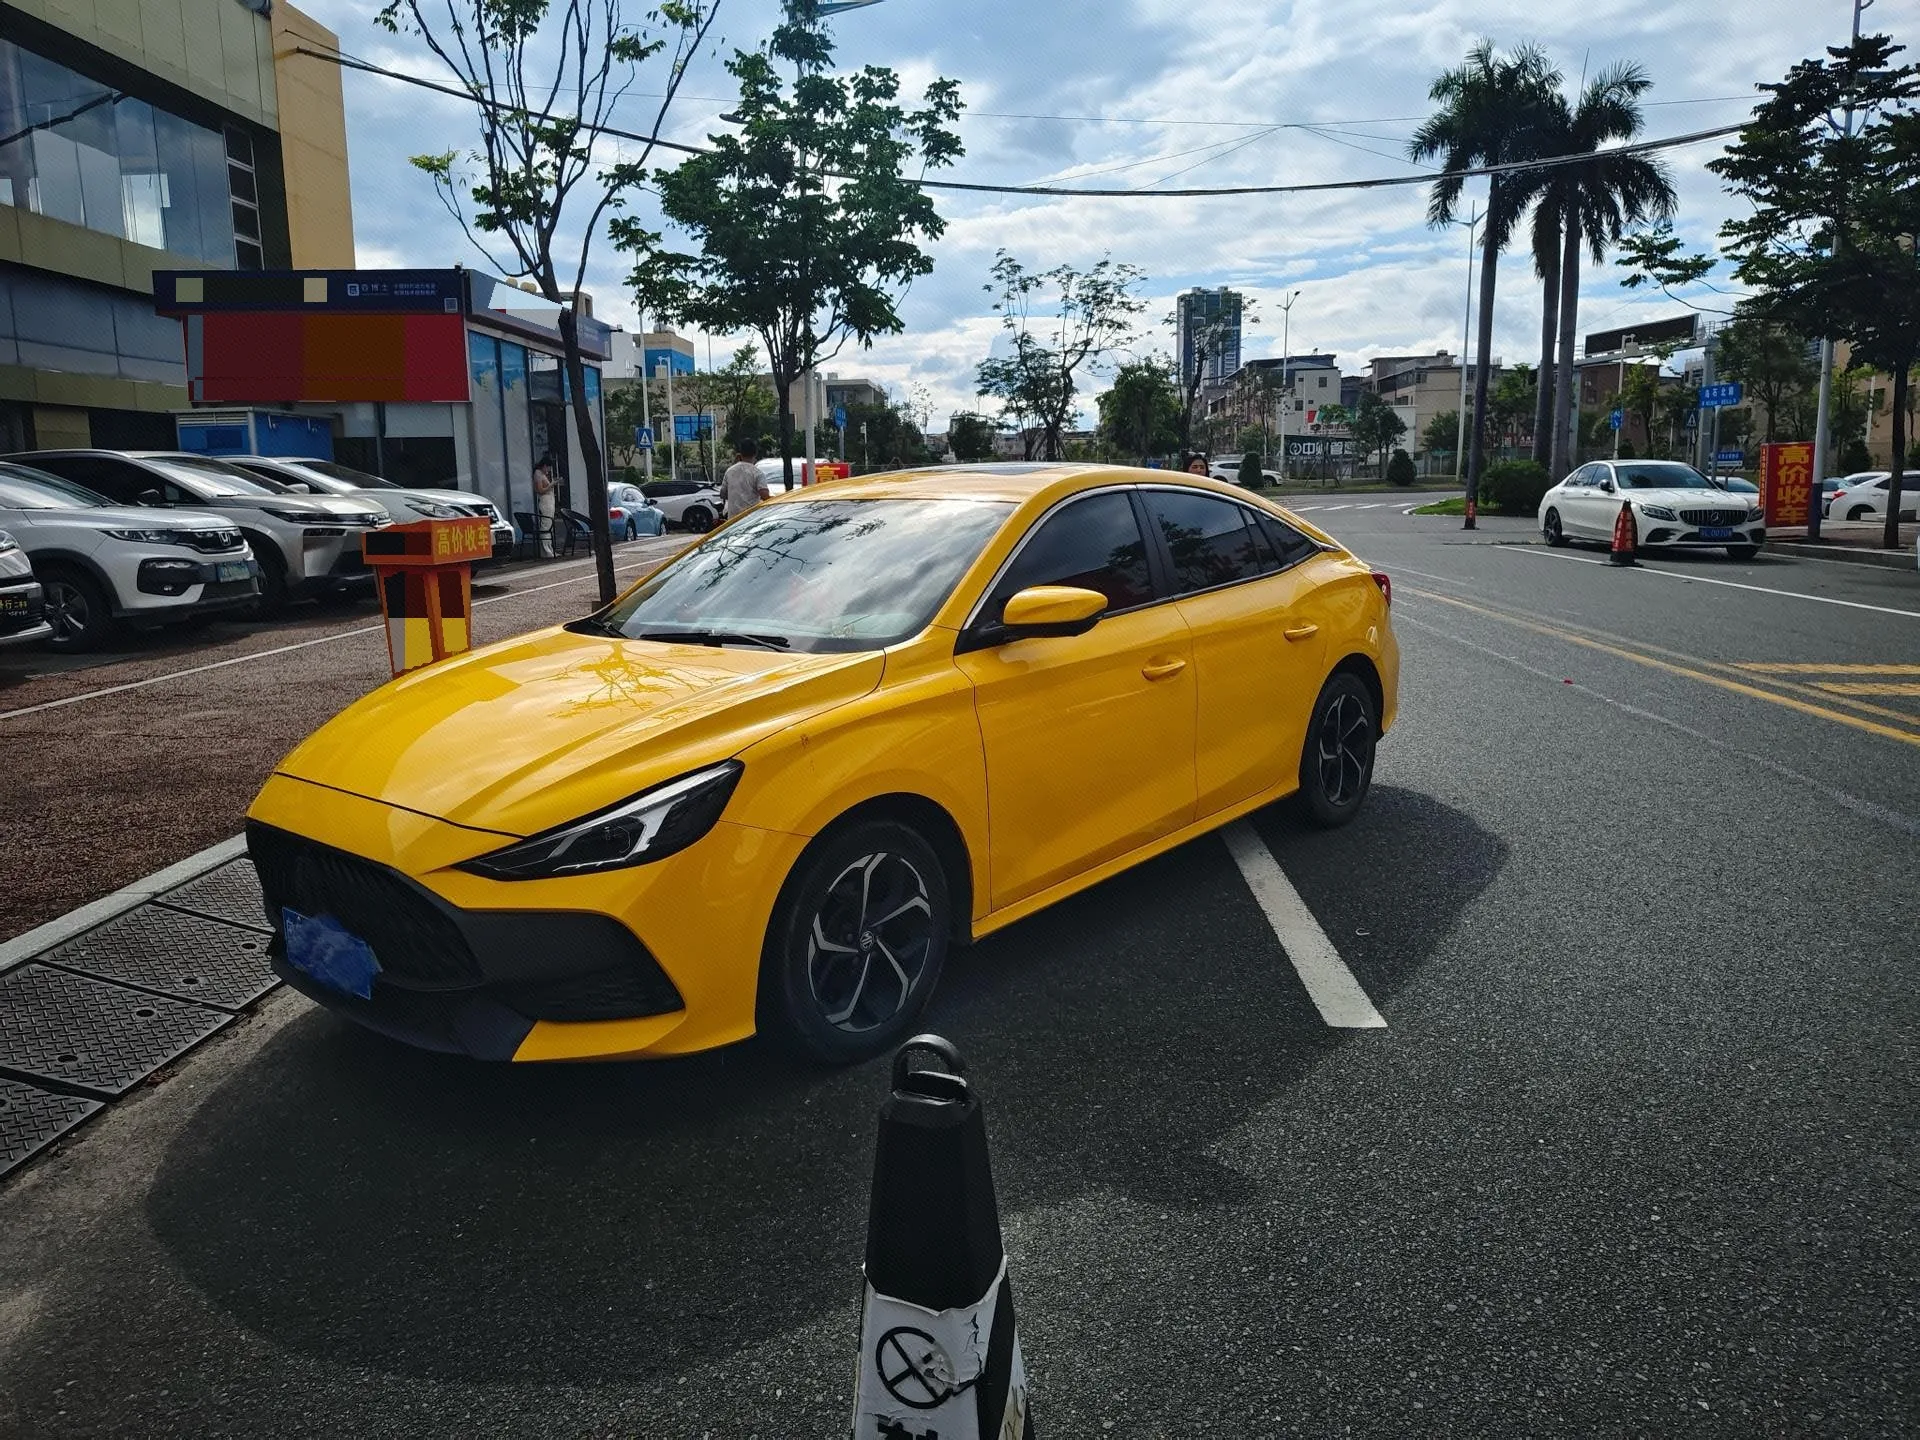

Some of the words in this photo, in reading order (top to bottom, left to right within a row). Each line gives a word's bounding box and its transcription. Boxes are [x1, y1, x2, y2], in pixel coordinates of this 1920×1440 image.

[1776, 446, 1810, 523] 高价收车
[437, 524, 489, 556] 高价收车
